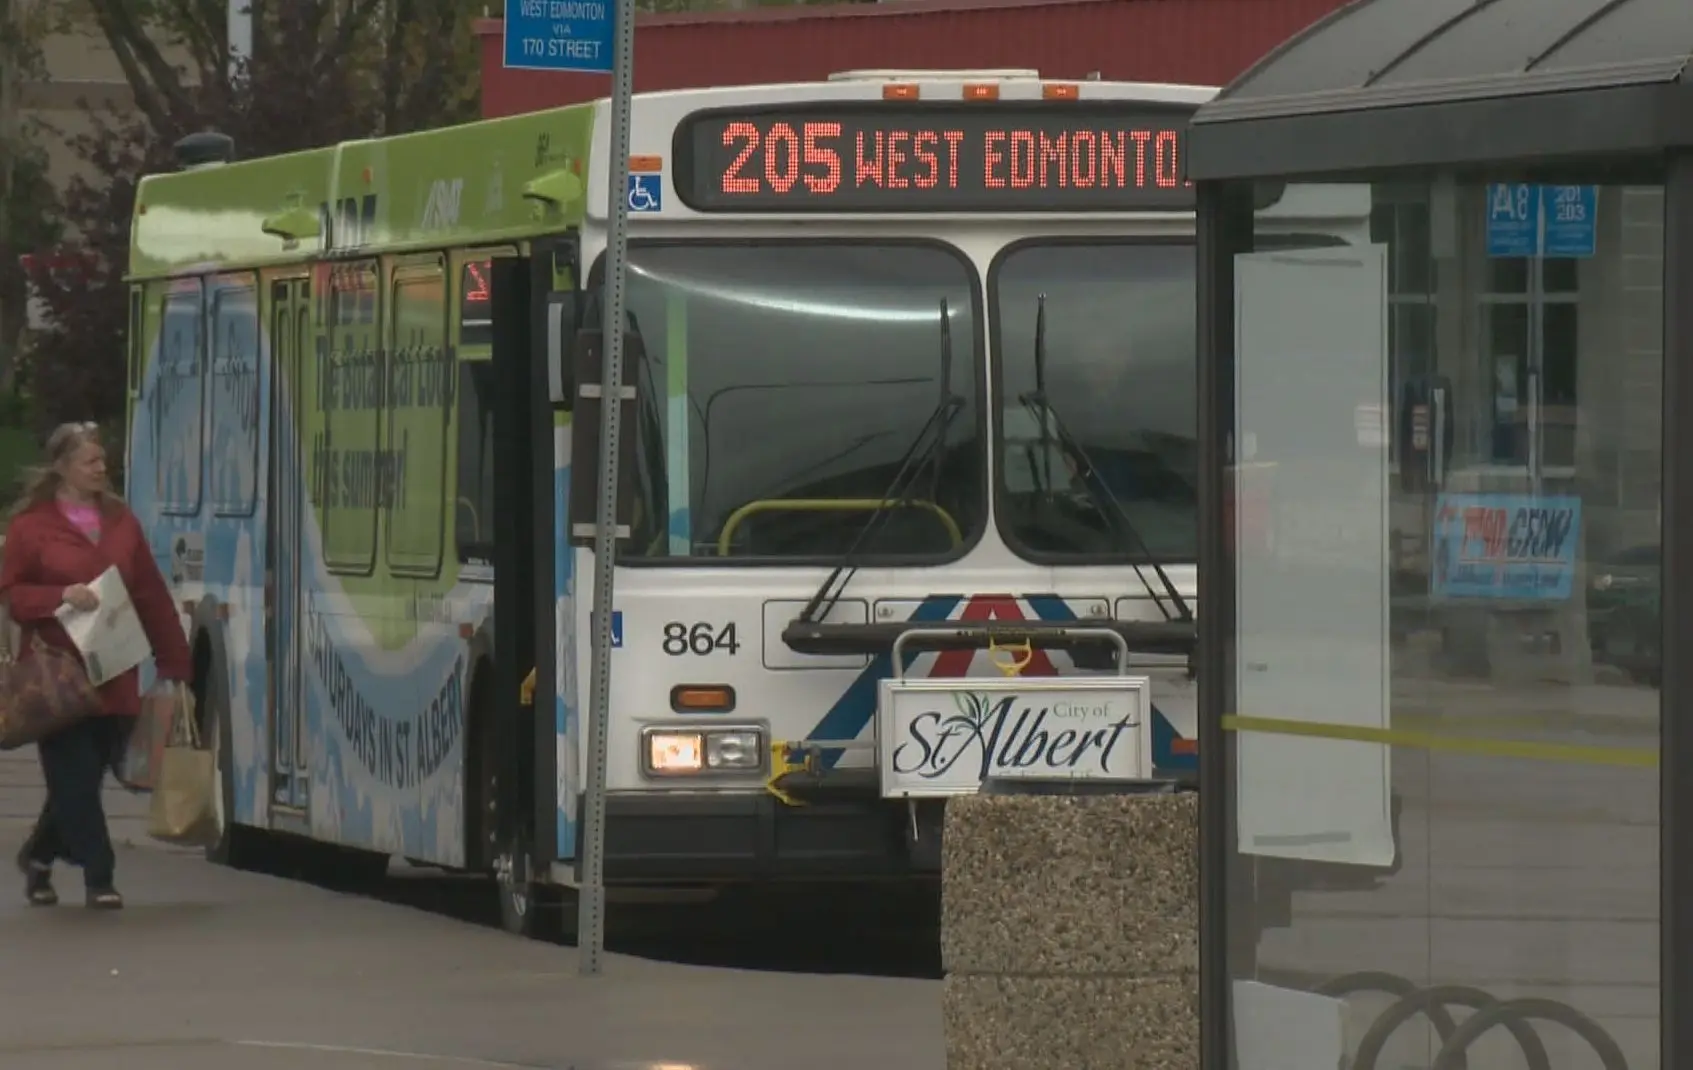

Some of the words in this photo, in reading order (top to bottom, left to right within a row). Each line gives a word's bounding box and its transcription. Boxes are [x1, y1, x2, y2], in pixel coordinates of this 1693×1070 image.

[520, 0, 546, 17] WEST
[550, 1, 605, 20] EDMONTON
[552, 25, 572, 36] VIA
[522, 38, 545, 57] 170
[548, 39, 602, 59] STREET
[721, 121, 842, 194] 205
[854, 130, 964, 188] WEST
[983, 129, 1192, 189] EDMONTO
[1555, 203, 1586, 221] 203
[661, 621, 741, 657] 864
[307, 586, 376, 776] SATURDAYS
[379, 713, 393, 789] IN
[417, 652, 464, 785] ALBERT
[1053, 700, 1091, 723] City
[1092, 700, 1114, 719] of
[919, 694, 1141, 781] Albert
